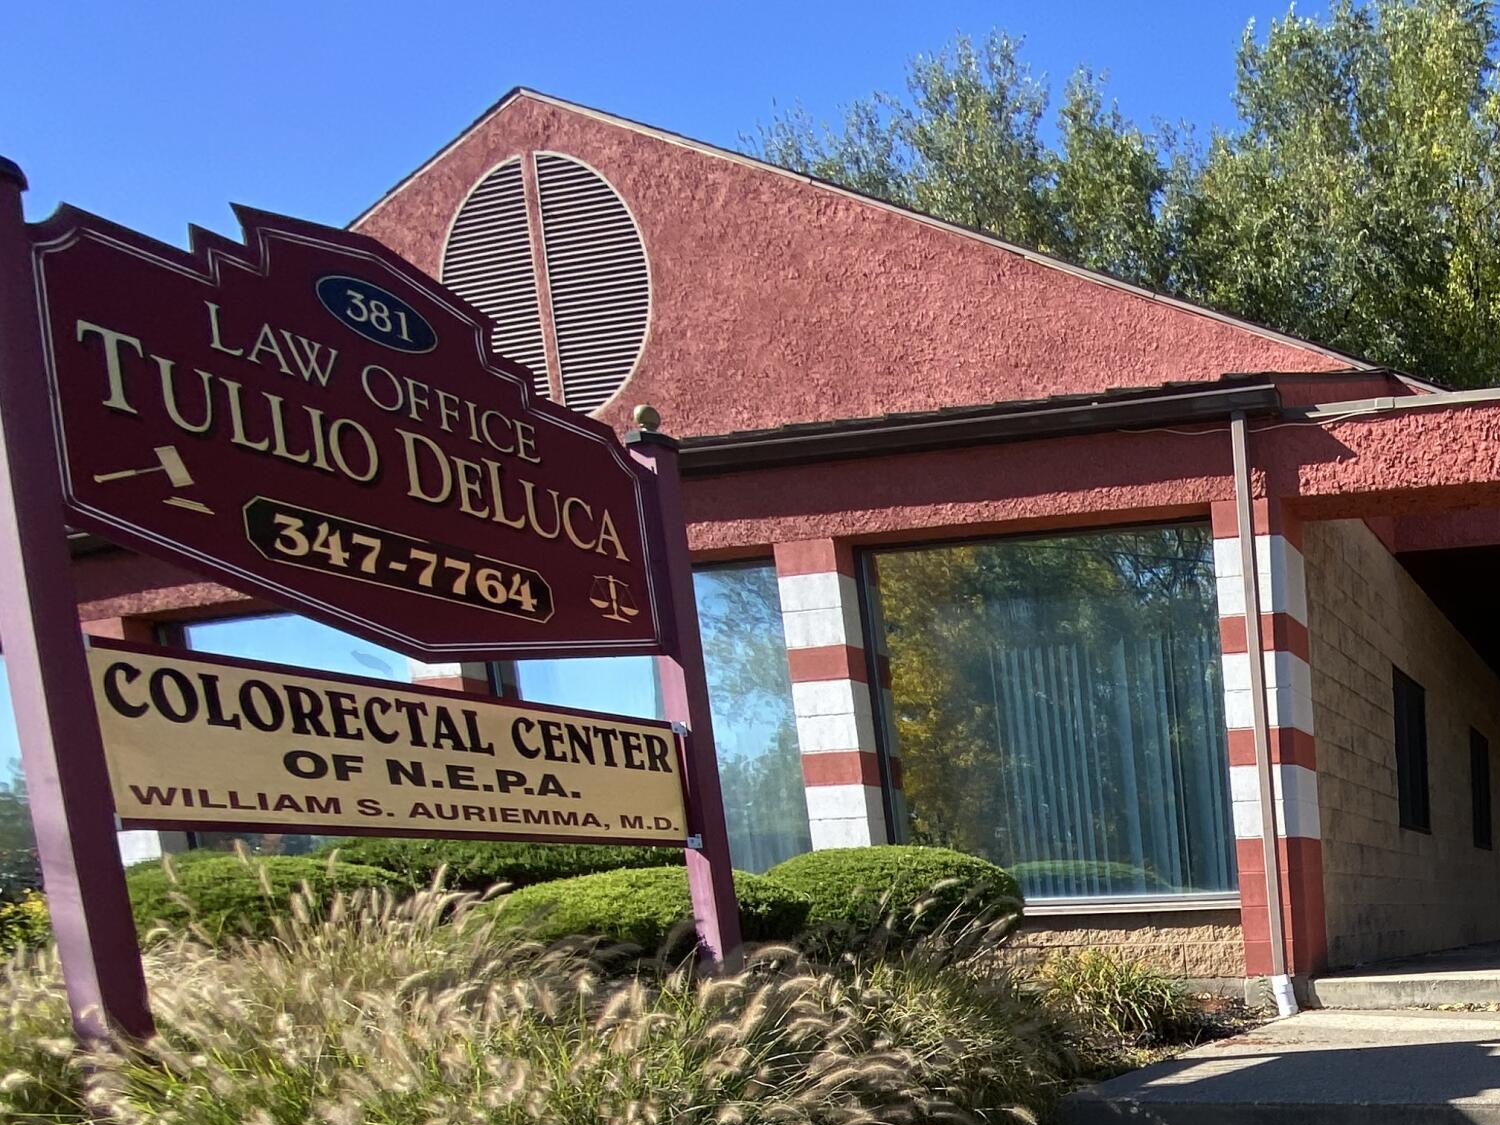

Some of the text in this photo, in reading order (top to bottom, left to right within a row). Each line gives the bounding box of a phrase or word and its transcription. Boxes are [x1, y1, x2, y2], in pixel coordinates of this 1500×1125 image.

[344, 289, 416, 343] 381
[76, 319, 379, 484] TULLIO
[203, 300, 542, 465] LAW OFFICE
[272, 511, 538, 614] 347-7764
[103, 660, 674, 774] COLORECTAL CENTER
[129, 783, 680, 833] WILLIAM S. AURIEMMA, M.D.
[282, 749, 582, 799] OF N.E.P.A.
